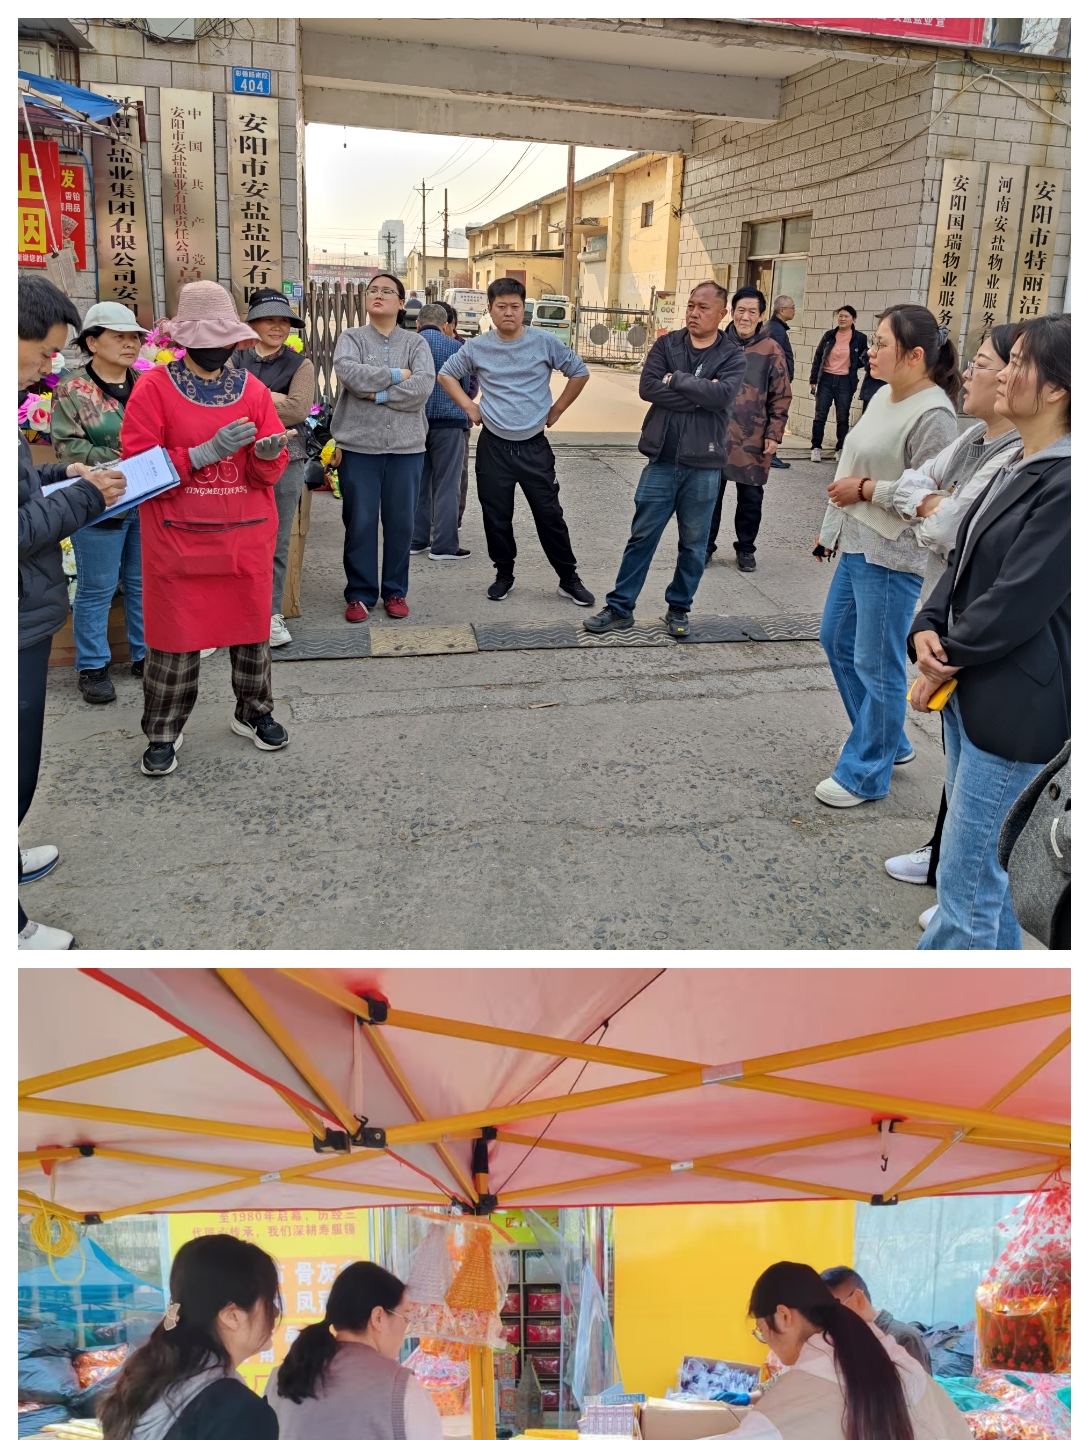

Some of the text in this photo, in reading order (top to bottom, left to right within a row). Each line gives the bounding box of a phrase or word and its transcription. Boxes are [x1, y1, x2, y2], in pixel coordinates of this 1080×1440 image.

[240, 79, 264, 93] 404
[60, 169, 76, 189] 发
[107, 95, 140, 317] 南盐业集团有限公司安
[170, 106, 190, 265] 安阳市安盐盐业有限责任公司
[187, 107, 206, 266] 中国共产党
[1018, 180, 1057, 323] 安阳市特丽洁
